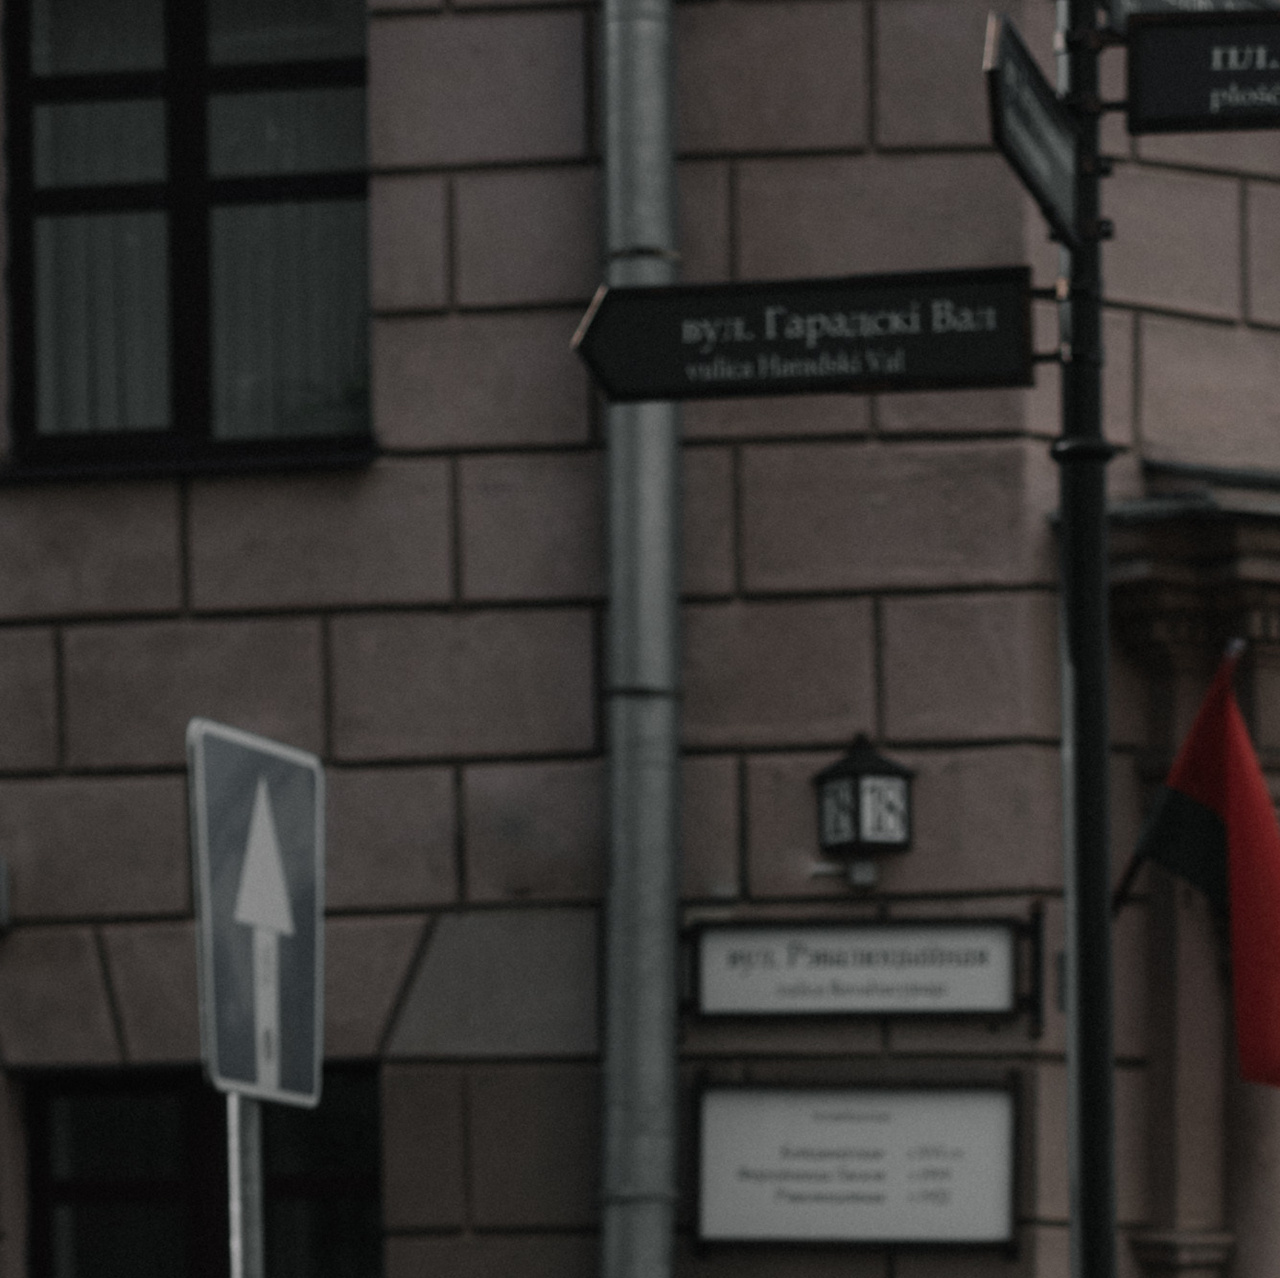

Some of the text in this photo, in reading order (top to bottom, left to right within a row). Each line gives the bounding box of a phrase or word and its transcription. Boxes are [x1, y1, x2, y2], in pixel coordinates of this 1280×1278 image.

[1210, 45, 1280, 71] пл.
[681, 299, 997, 355] вул. Гарадскі Вал
